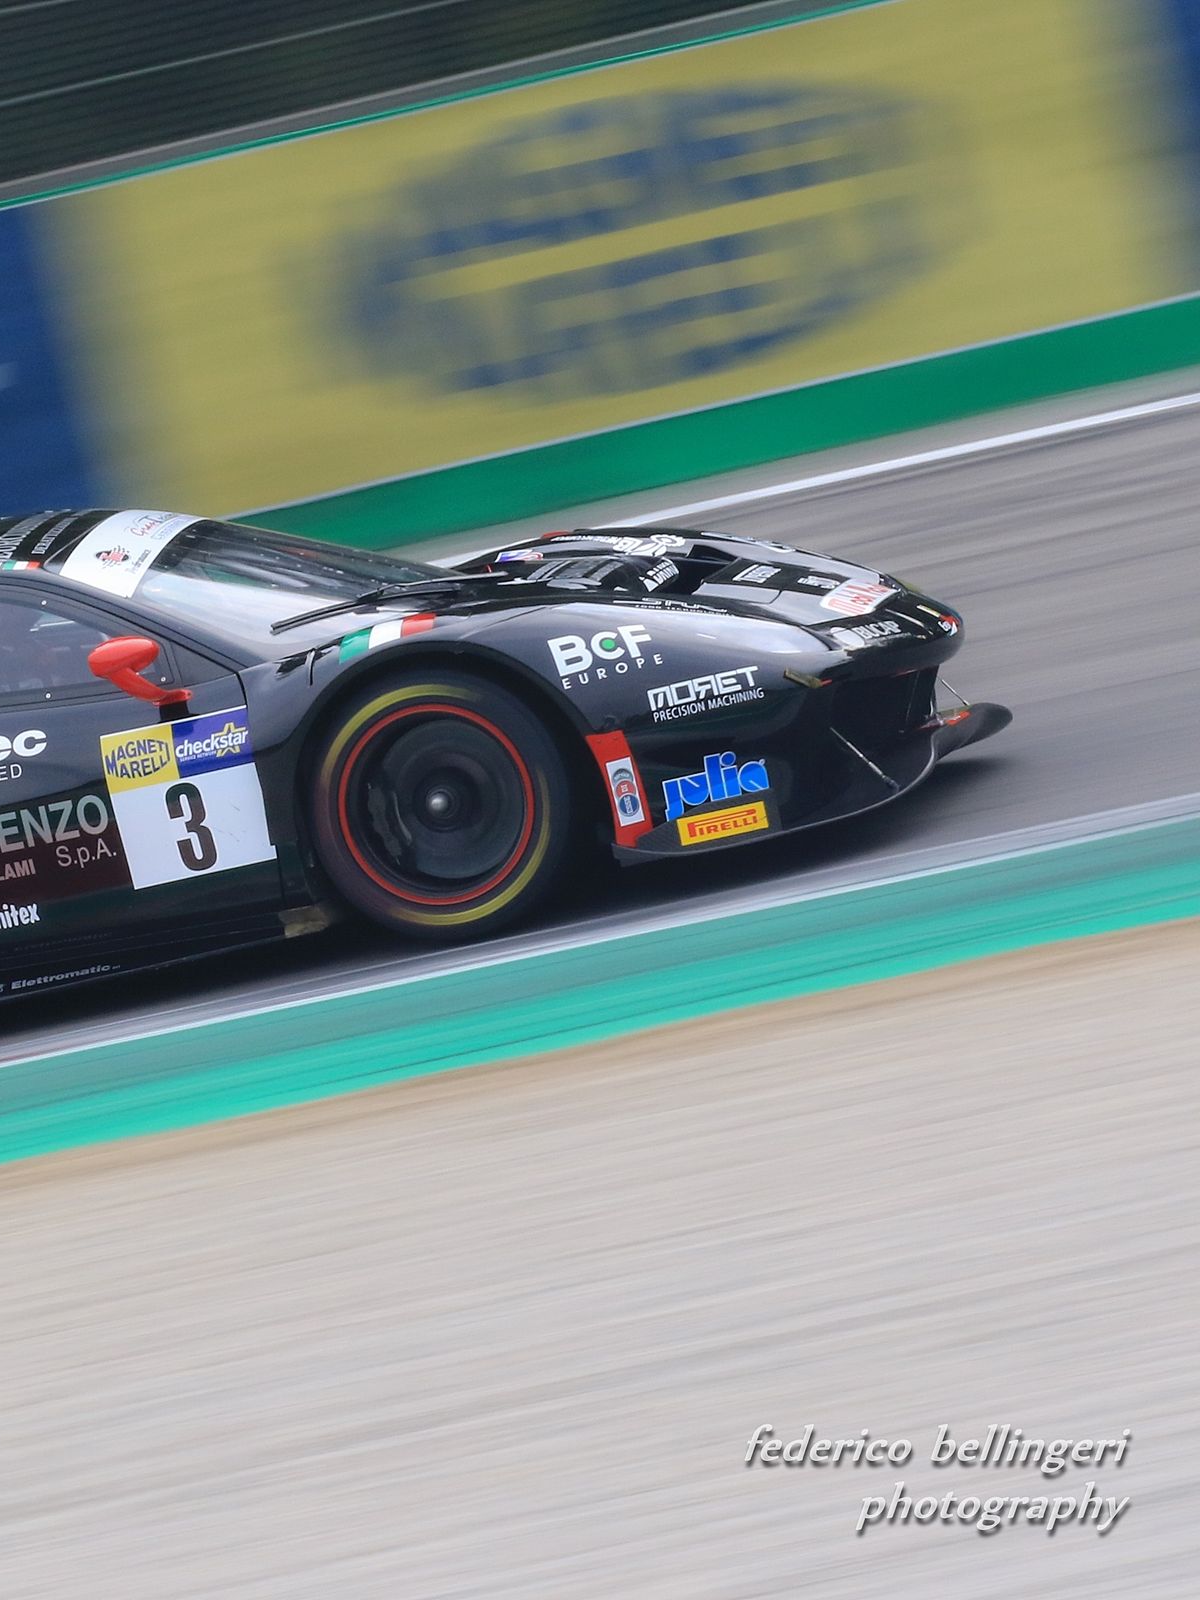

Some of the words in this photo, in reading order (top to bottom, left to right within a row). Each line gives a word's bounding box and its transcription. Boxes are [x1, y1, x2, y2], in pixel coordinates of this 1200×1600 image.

[852, 620, 900, 641] BUCAP
[547, 624, 652, 677] BCF
[562, 653, 663, 690] EUROPE
[653, 701, 706, 723] PRECISION
[708, 687, 765, 710] MACHINING
[175, 729, 249, 759] checkstar
[662, 751, 771, 822] julia
[164, 782, 218, 872] 3
[688, 808, 760, 839] PIRELLI
[56, 837, 117, 868] S.p.A.
[11, 965, 111, 990] Elettromatic
